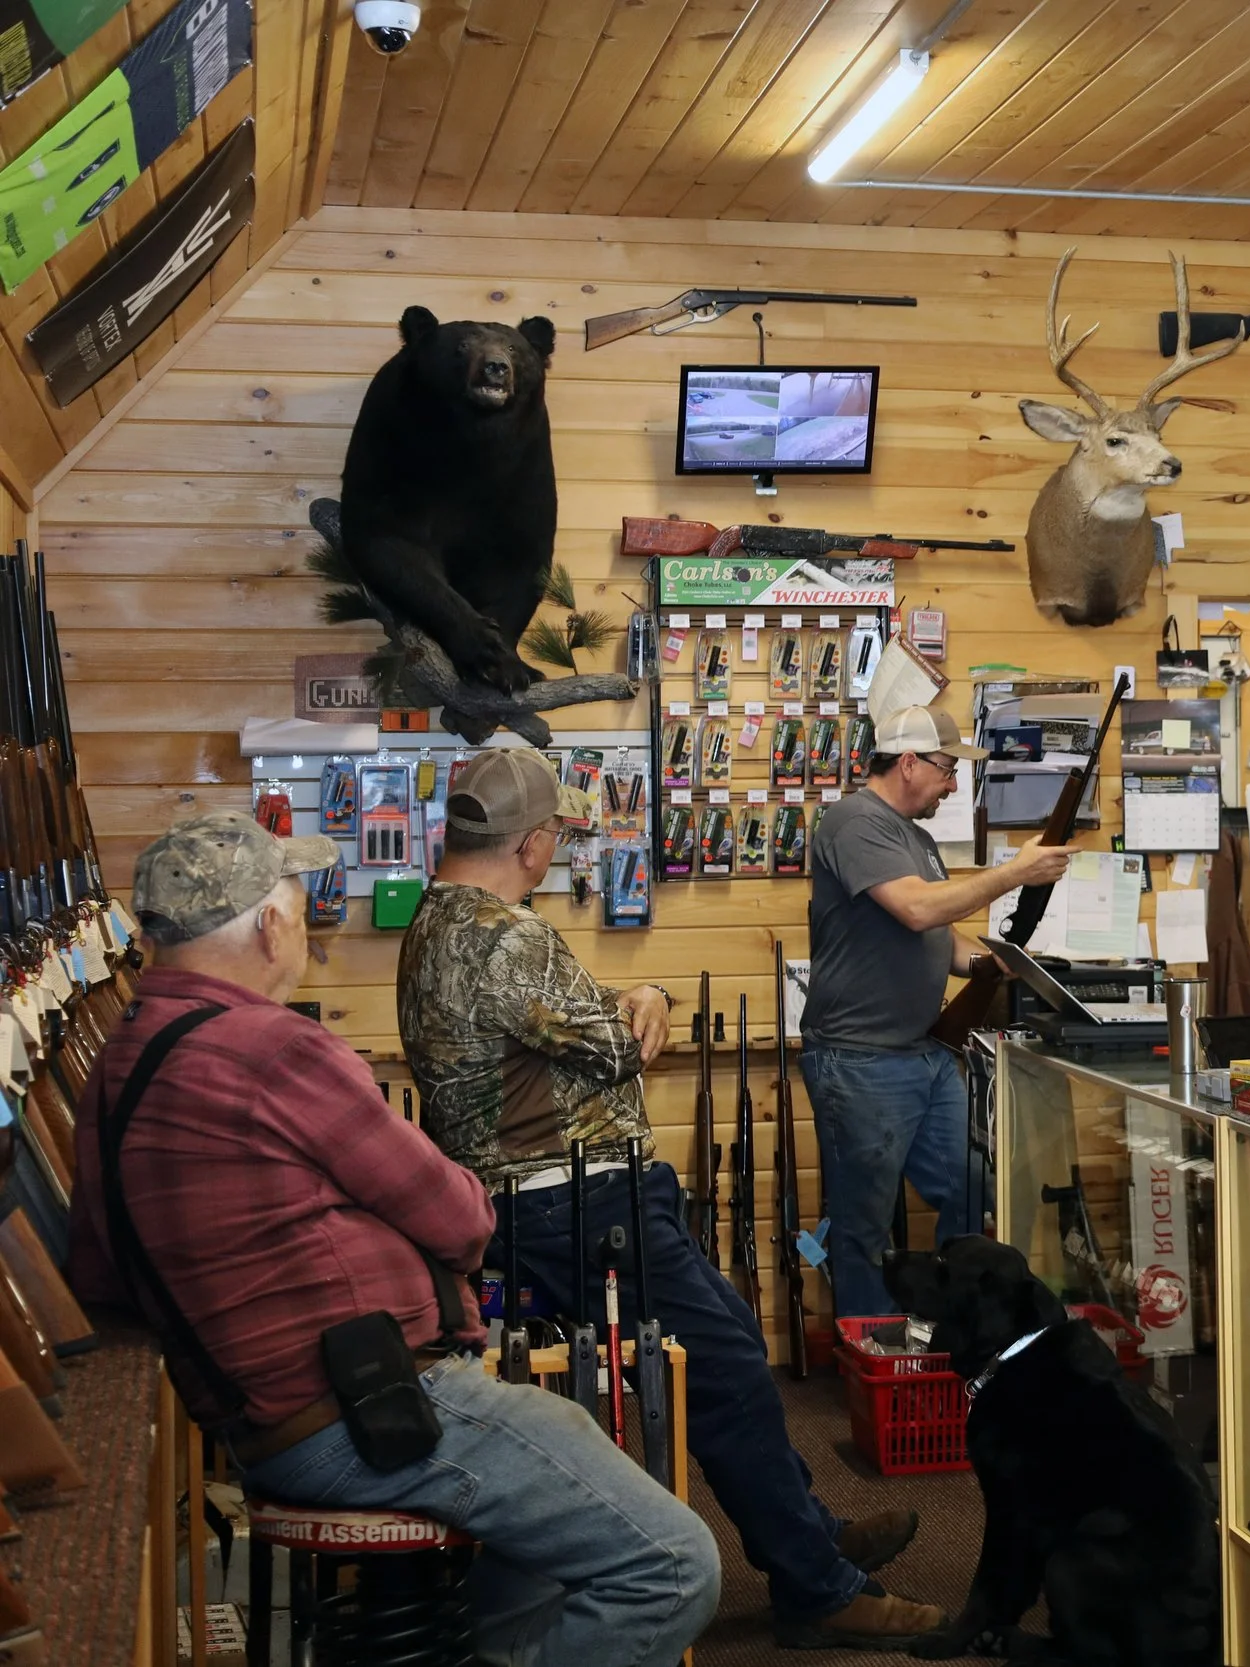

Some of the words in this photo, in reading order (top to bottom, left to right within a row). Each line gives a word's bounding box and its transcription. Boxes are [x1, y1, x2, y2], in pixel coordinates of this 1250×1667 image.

[97, 305, 122, 352] VORTEX
[771, 589, 889, 604] WINCHESTER
[318, 1519, 448, 1544] Assembly
